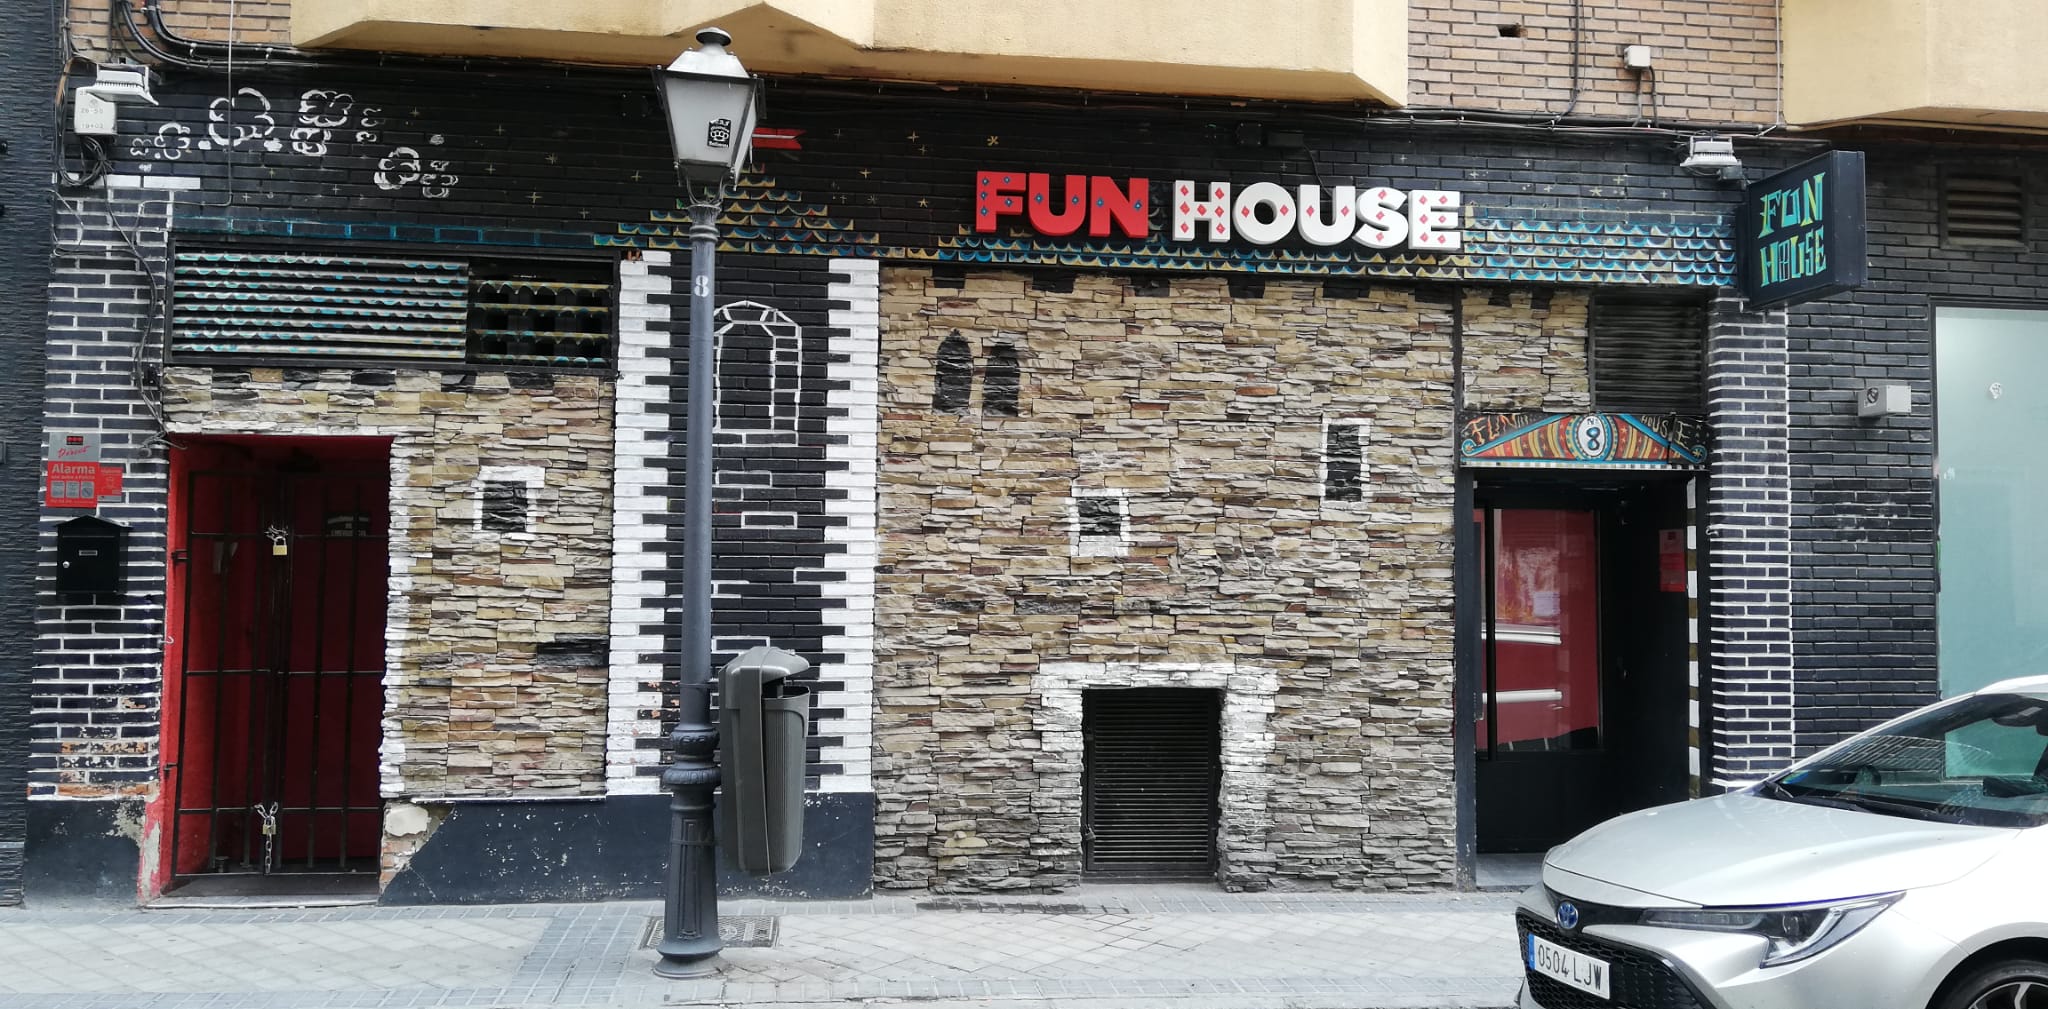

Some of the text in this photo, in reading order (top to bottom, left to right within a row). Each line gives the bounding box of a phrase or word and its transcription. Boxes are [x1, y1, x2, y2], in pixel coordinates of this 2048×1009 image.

[976, 170, 1461, 249] FUN HOUSE
[1758, 172, 1826, 238] FUN
[1760, 225, 1827, 287] HOUSE
[694, 274, 710, 297] 8
[1586, 426, 1600, 451] 8
[51, 463, 96, 475] Alarma
[1538, 944, 1602, 991] 0504 LJW
